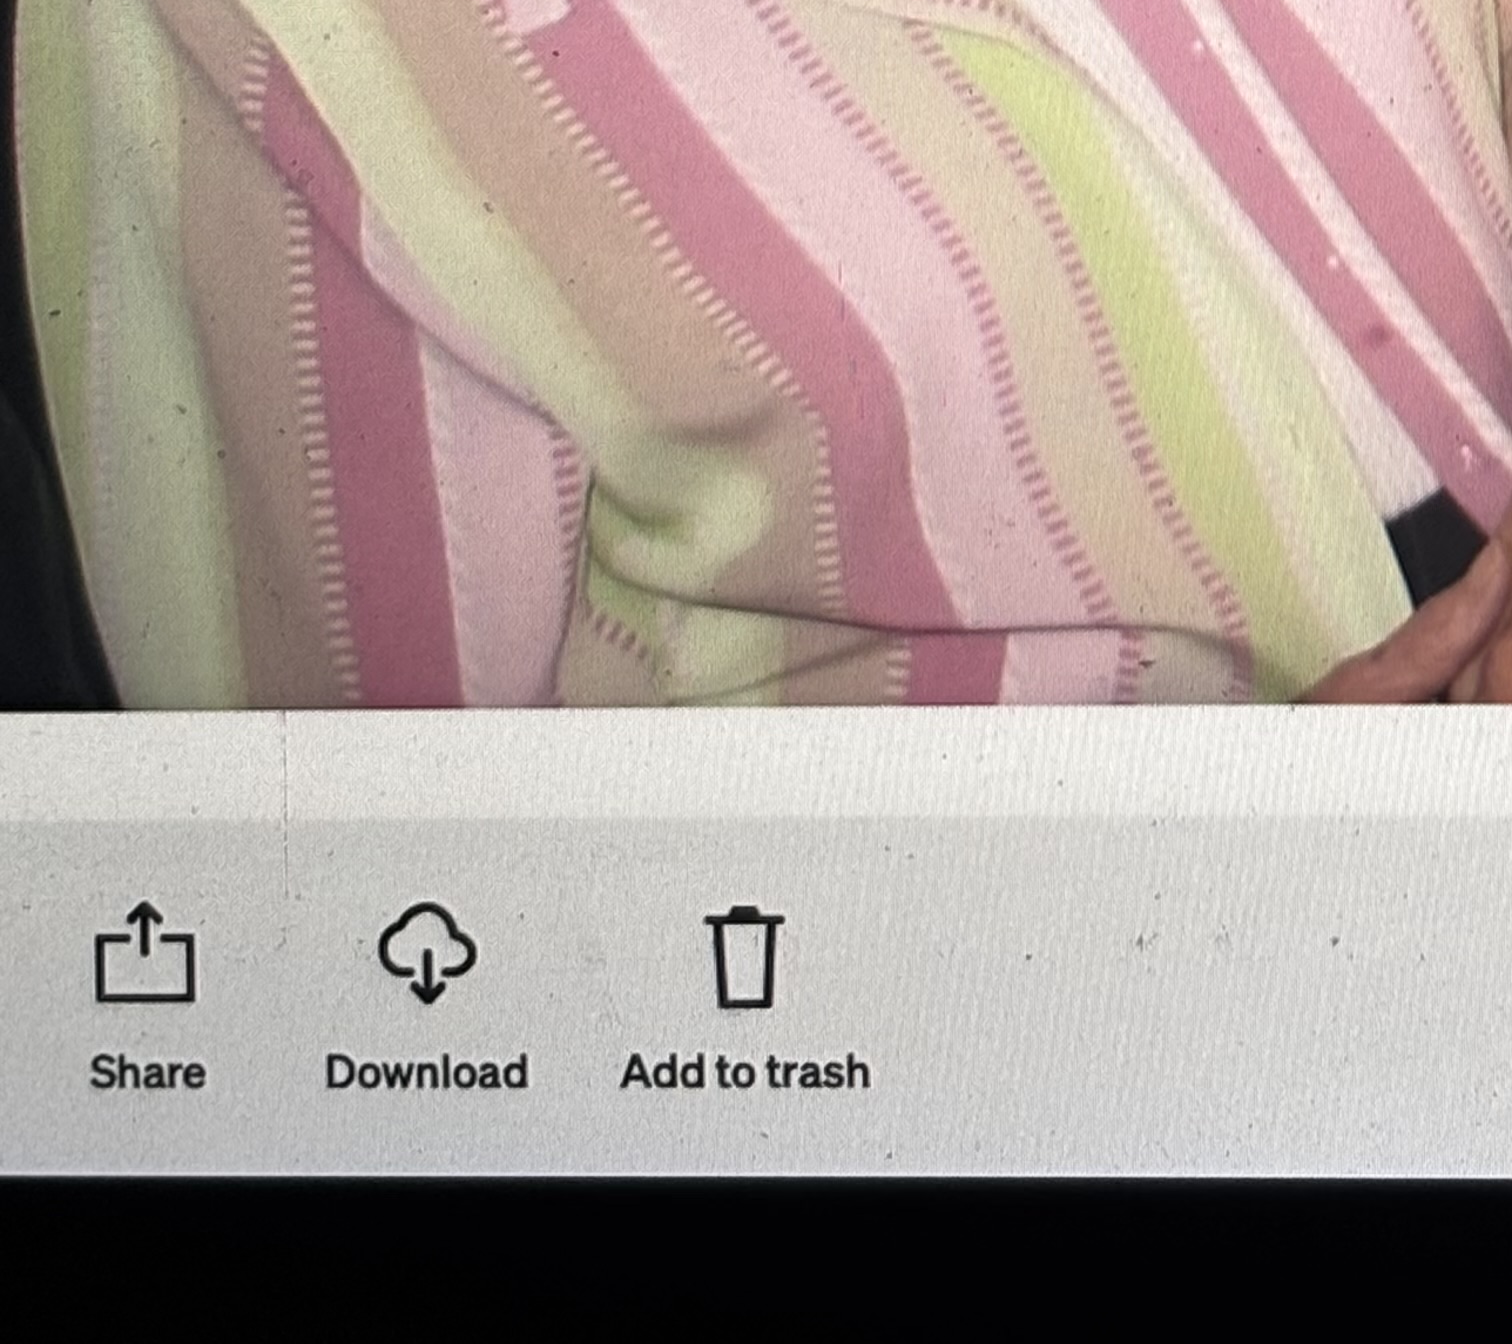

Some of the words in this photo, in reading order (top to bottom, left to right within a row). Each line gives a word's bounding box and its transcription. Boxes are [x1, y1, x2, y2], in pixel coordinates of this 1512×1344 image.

[90, 1053, 206, 1090] Share
[326, 1053, 528, 1090] Download
[619, 1053, 705, 1089] Add
[715, 1055, 756, 1089] to
[765, 1053, 870, 1089] trash
